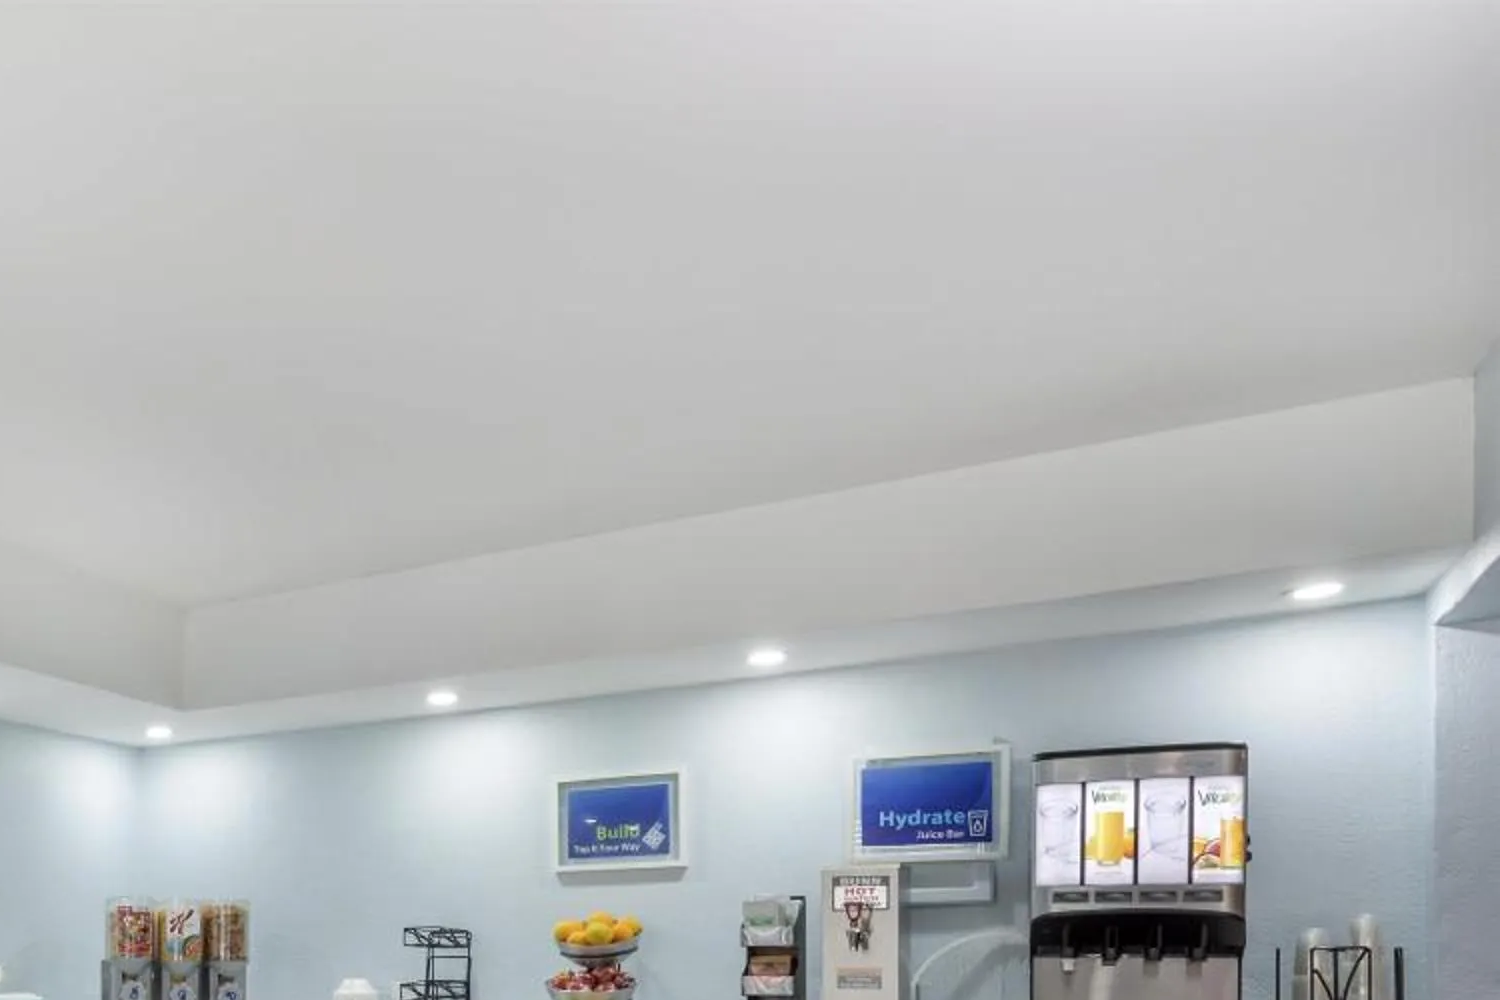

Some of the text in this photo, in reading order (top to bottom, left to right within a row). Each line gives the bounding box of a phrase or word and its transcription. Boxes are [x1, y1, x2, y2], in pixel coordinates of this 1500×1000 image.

[879, 808, 966, 832] Hydrate
[596, 823, 641, 841] Build
[915, 830, 945, 840] Juice
